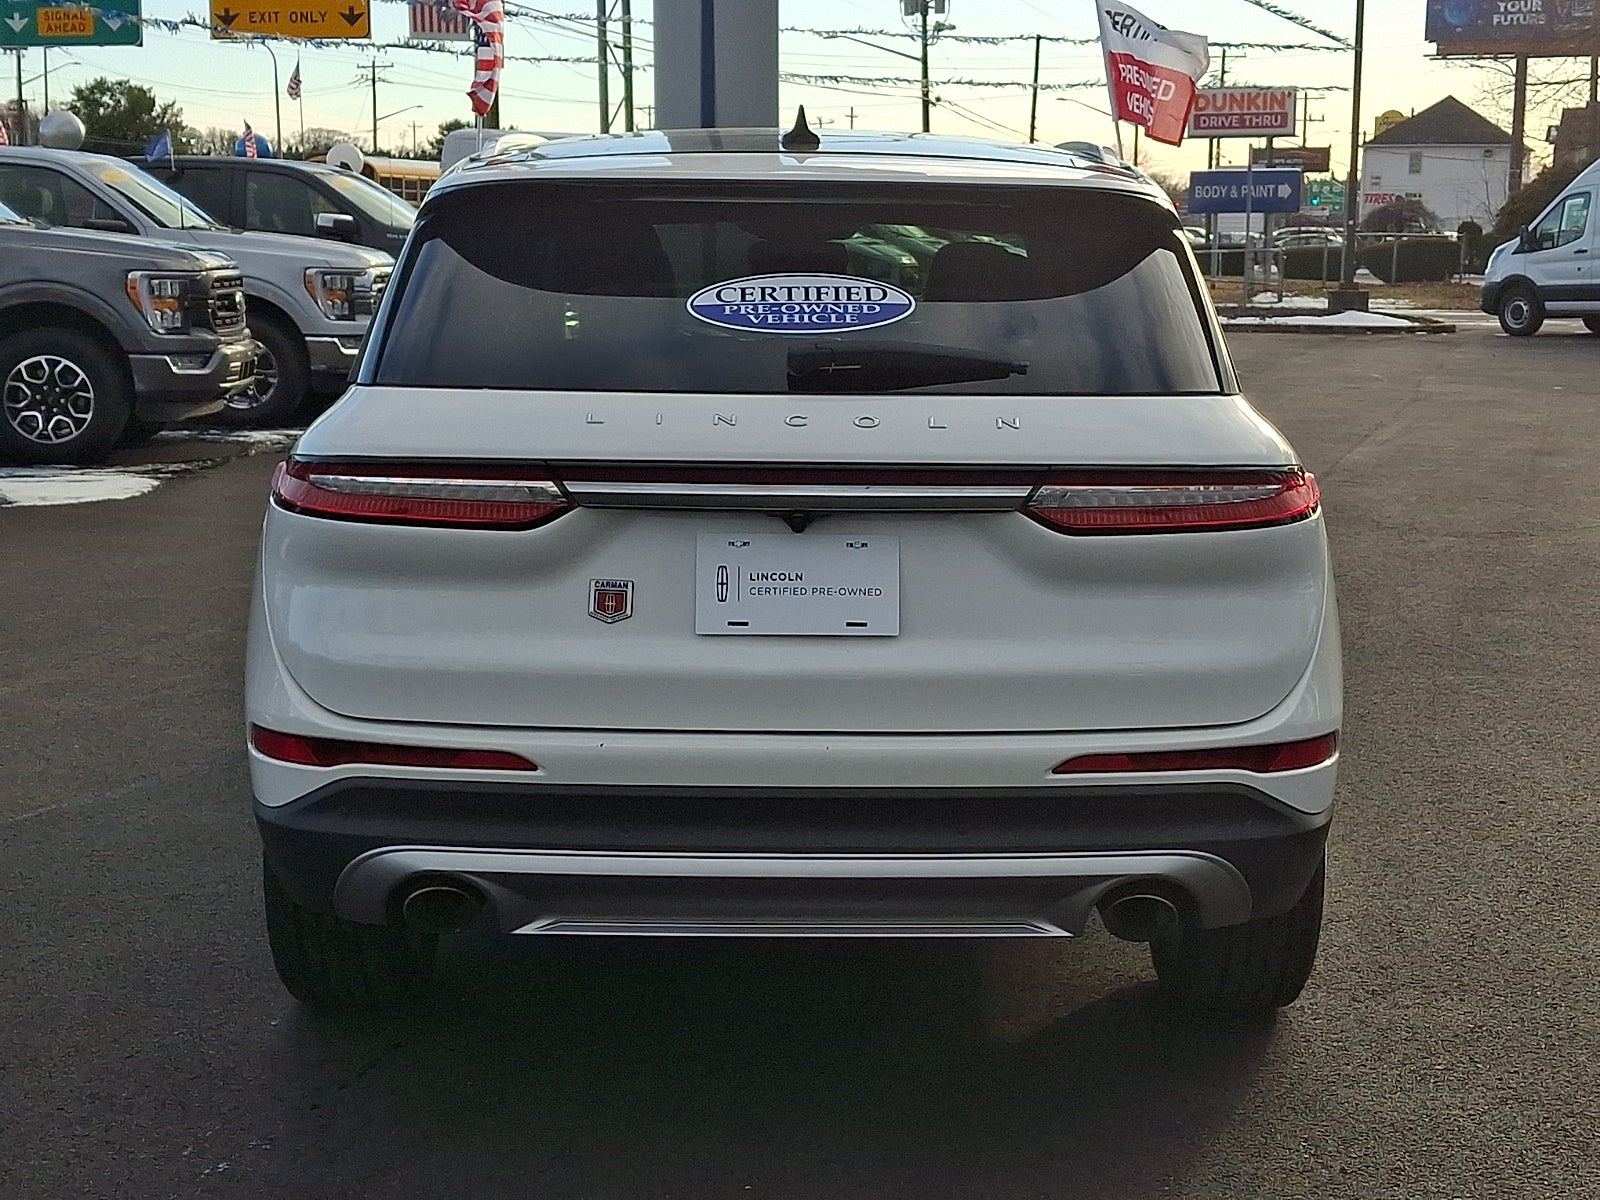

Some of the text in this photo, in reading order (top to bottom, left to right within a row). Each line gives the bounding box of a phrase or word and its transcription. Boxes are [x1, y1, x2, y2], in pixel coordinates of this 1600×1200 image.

[1497, 0, 1542, 12] YOUR
[44, 10, 86, 21] SIGNAL
[249, 11, 327, 23] EXIT ONLY
[1493, 13, 1546, 26] FUTURE
[46, 22, 85, 32] AHEAD
[1118, 63, 1176, 101] PRE-OED
[1194, 91, 1292, 112] DUNKIN'
[1200, 114, 1281, 128] DRIVE THRU
[1195, 184, 1275, 198] BODY & PAINT
[1364, 192, 1396, 204] TIRES
[715, 286, 888, 303] CERTIFIED
[723, 303, 881, 315] PRE-OWNED
[746, 314, 859, 324] VEHICLE
[585, 412, 1021, 431] LINCOLN
[749, 572, 803, 582] LINCOLN
[594, 580, 629, 589] CARMAN
[749, 586, 882, 597] CERTIFIED PRE-OWNED
